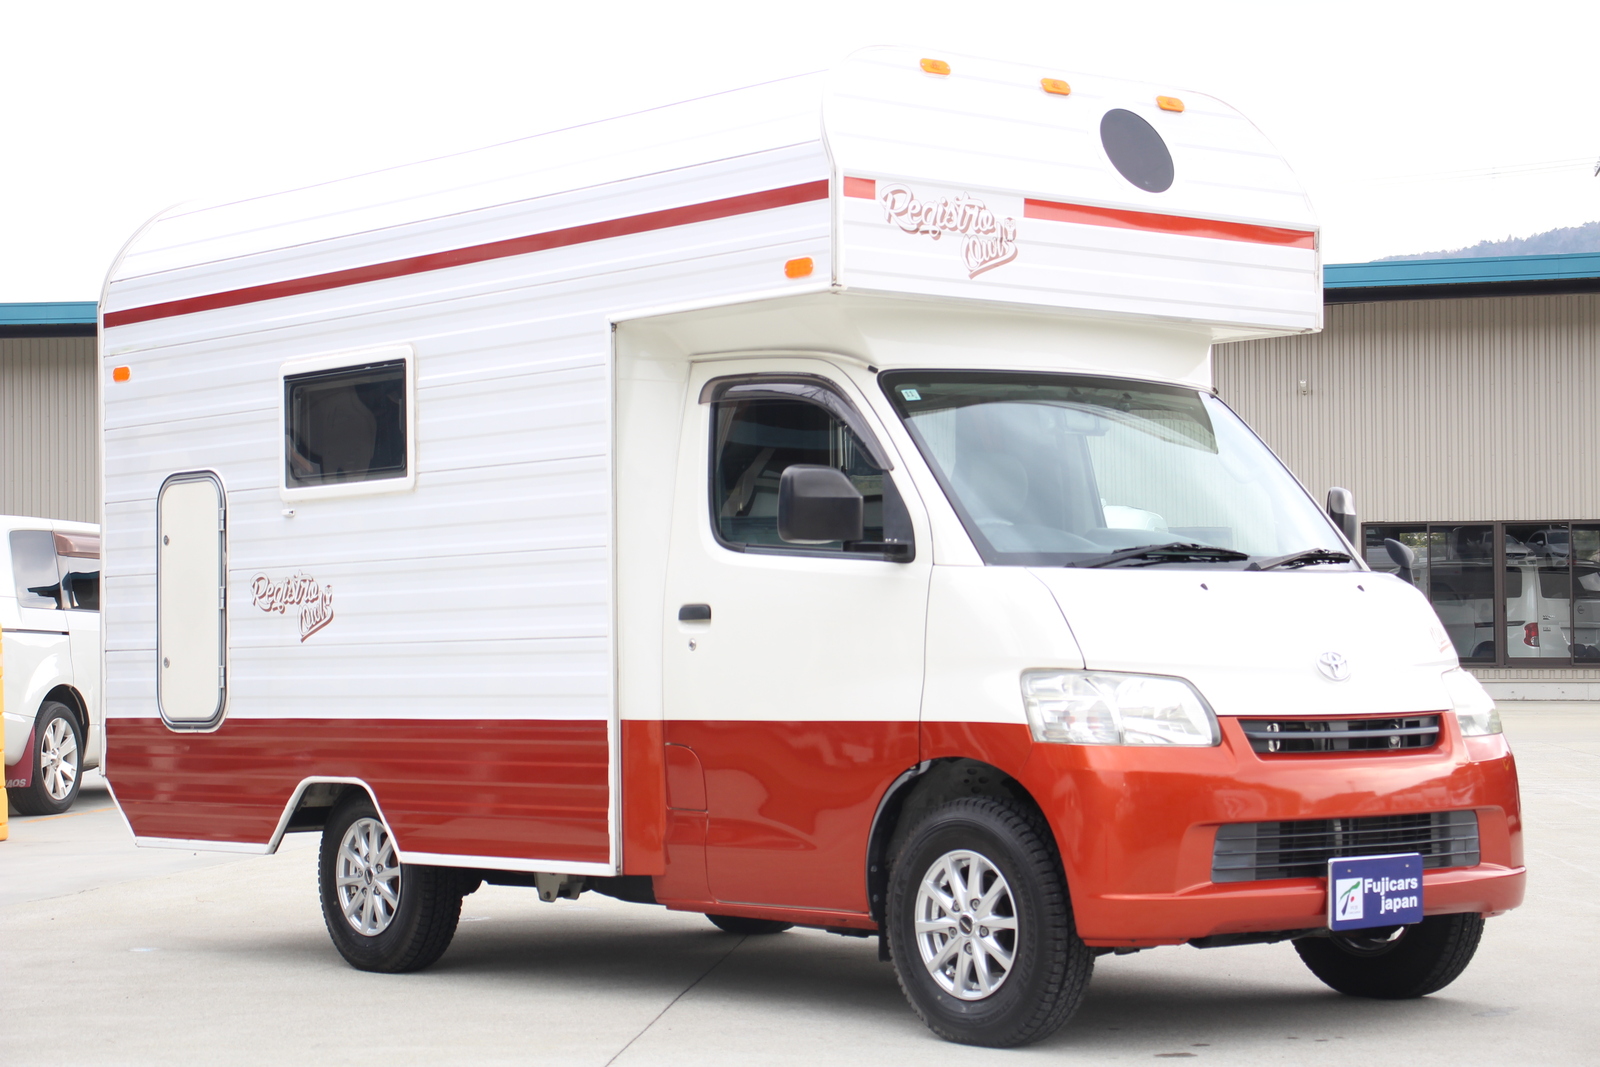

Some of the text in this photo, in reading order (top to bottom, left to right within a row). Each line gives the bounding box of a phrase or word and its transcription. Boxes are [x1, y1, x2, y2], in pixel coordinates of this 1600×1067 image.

[880, 183, 996, 241] Registro
[1364, 877, 1418, 896] Fujicars
[1380, 895, 1418, 914] japan
